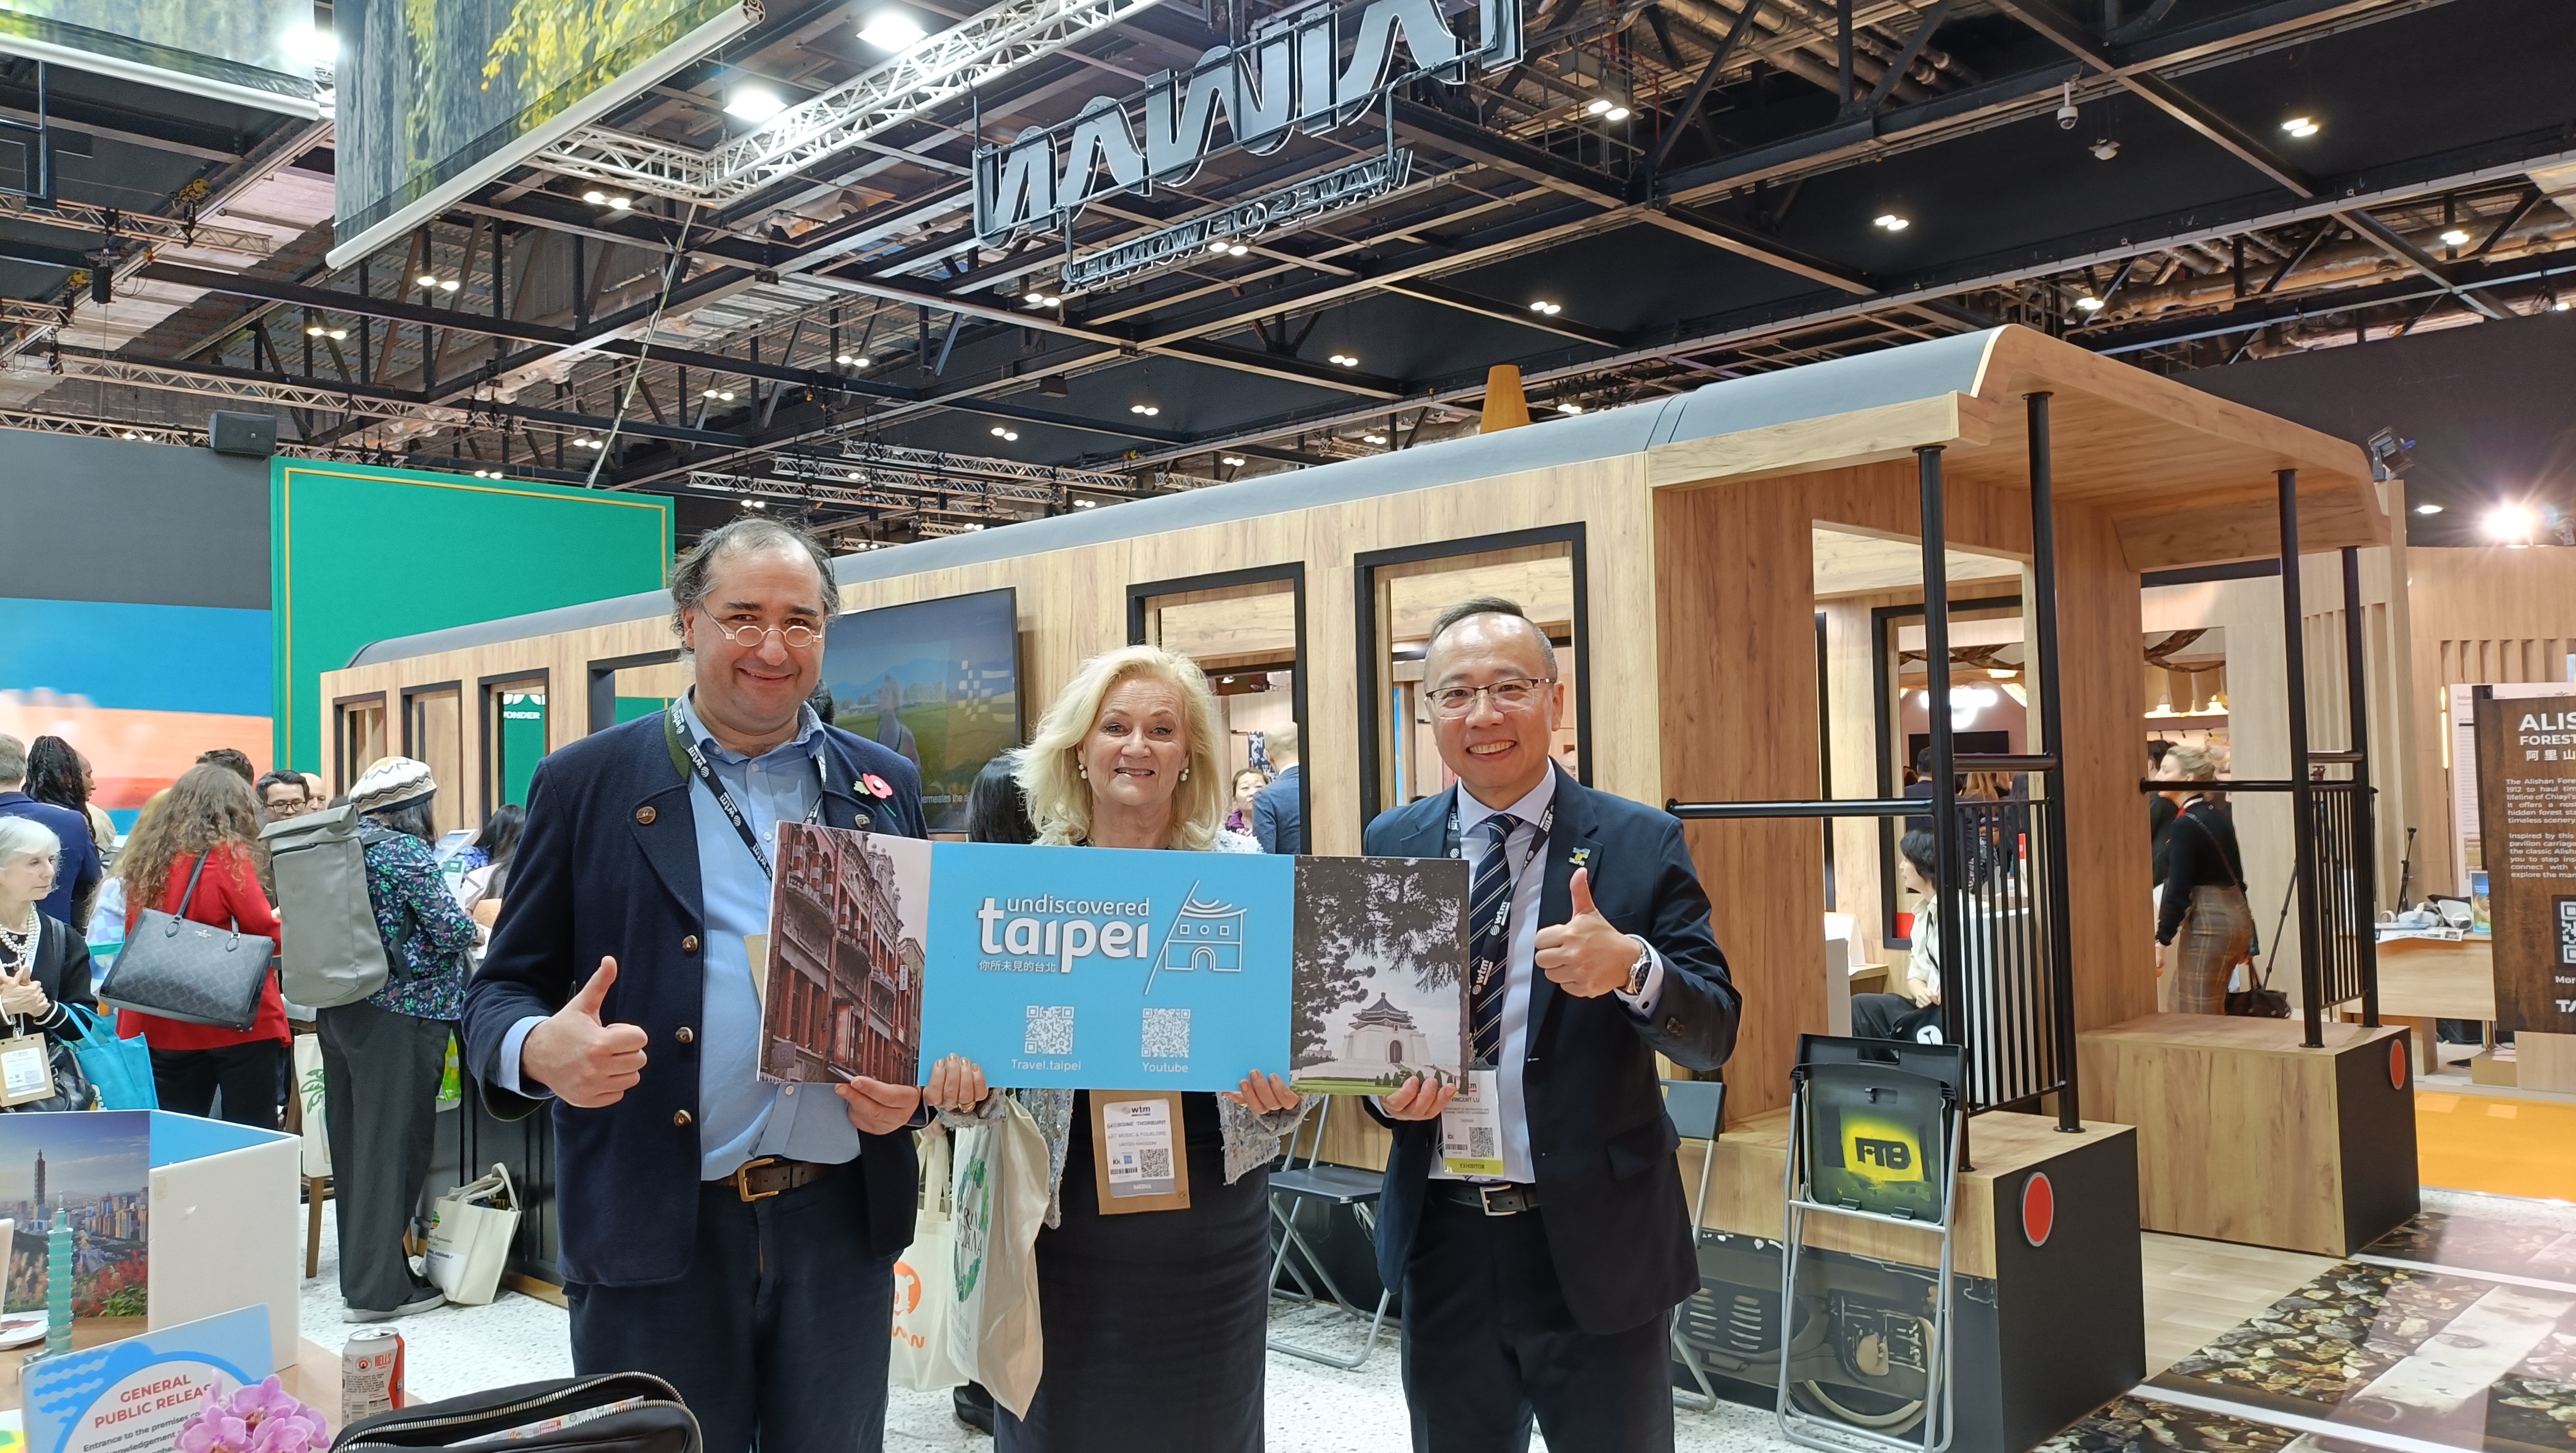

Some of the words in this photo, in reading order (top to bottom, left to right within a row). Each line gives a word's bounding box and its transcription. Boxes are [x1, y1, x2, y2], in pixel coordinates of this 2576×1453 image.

[687, 747, 704, 769] wtm
[719, 793, 735, 818] wtm
[1542, 813, 1554, 832] wtm
[752, 844, 768, 869] wtm
[1007, 894, 1150, 917] undiscovered
[1494, 901, 1507, 926] wtm
[978, 898, 1149, 973] taipei
[979, 959, 1056, 973] 你所未見的台北
[1476, 958, 1490, 985] wtm
[2555, 976, 2576, 984] Mor
[1011, 1059, 1082, 1072] Travel.taipei
[1143, 1062, 1189, 1073] Youtube
[374, 1353, 392, 1367] HELLS
[120, 1374, 192, 1403] GENERAL
[95, 1402, 152, 1428] PUBLIC
[84, 1434, 122, 1452] Entrance
[135, 1426, 150, 1436] the
[152, 1413, 189, 1432] premises
